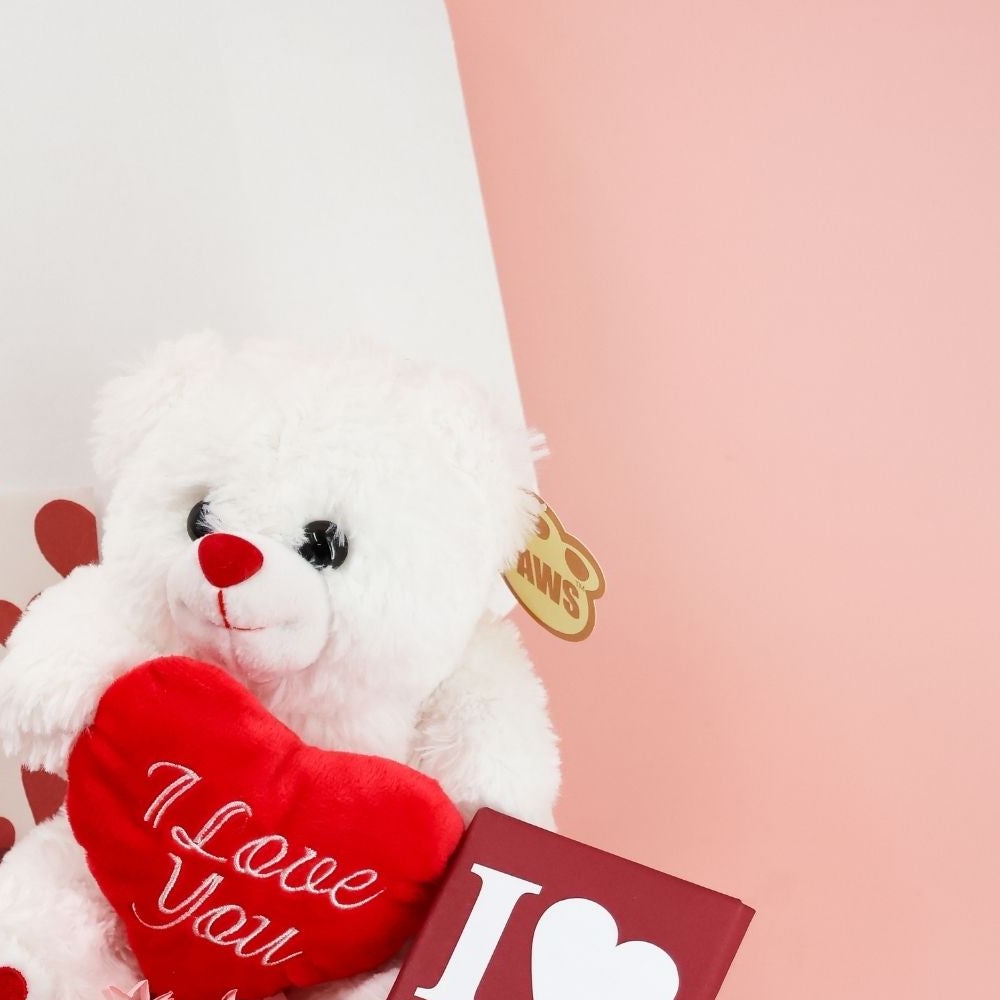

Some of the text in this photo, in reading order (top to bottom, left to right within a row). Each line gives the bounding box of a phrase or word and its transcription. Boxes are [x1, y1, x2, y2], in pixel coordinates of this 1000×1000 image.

[516, 549, 580, 619] AWS
[145, 761, 202, 829] I
[171, 801, 386, 909] Love
[132, 852, 304, 966] You
